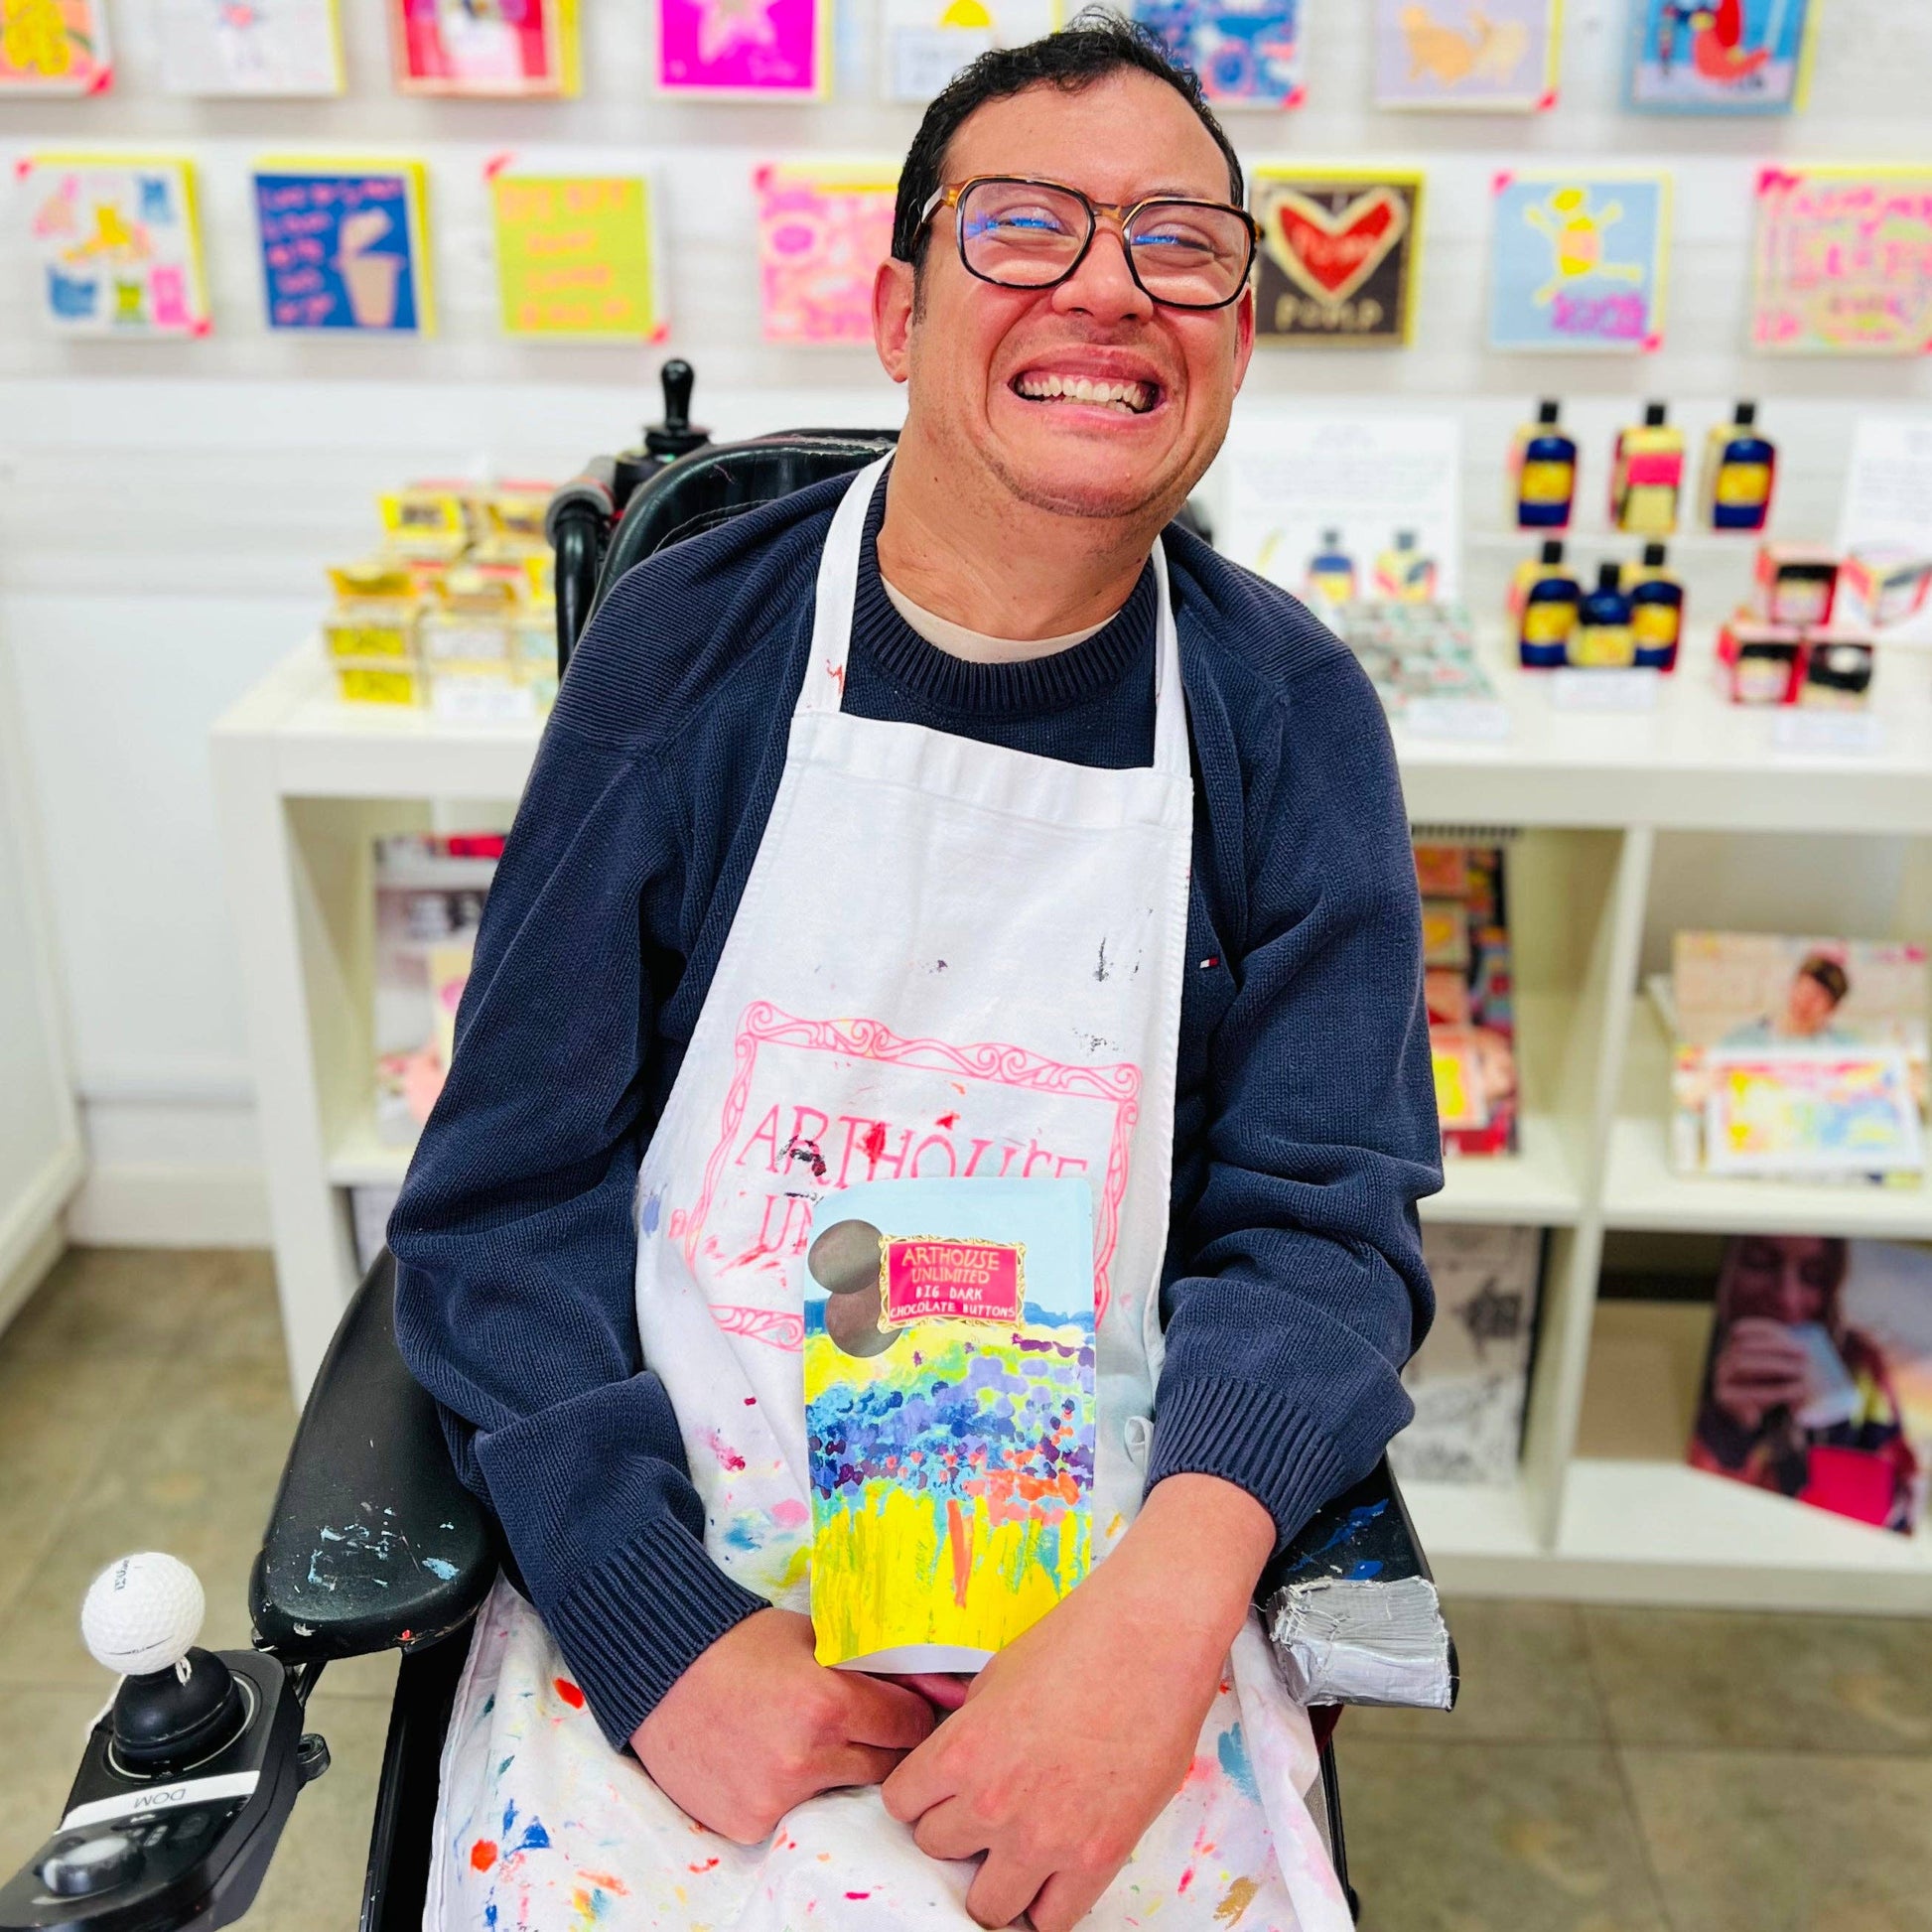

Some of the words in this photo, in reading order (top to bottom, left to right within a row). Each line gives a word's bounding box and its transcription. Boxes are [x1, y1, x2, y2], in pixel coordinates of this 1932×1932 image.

[901, 1246, 1000, 1271] ARTHOUSE
[911, 1267, 990, 1284] UNLIMITED
[915, 1285, 939, 1300] BIG
[950, 1287, 983, 1301] DARK
[890, 1302, 956, 1318] CHOCOLATE
[962, 1303, 1016, 1317] BUTTONS
[134, 1788, 187, 1808] DOM
